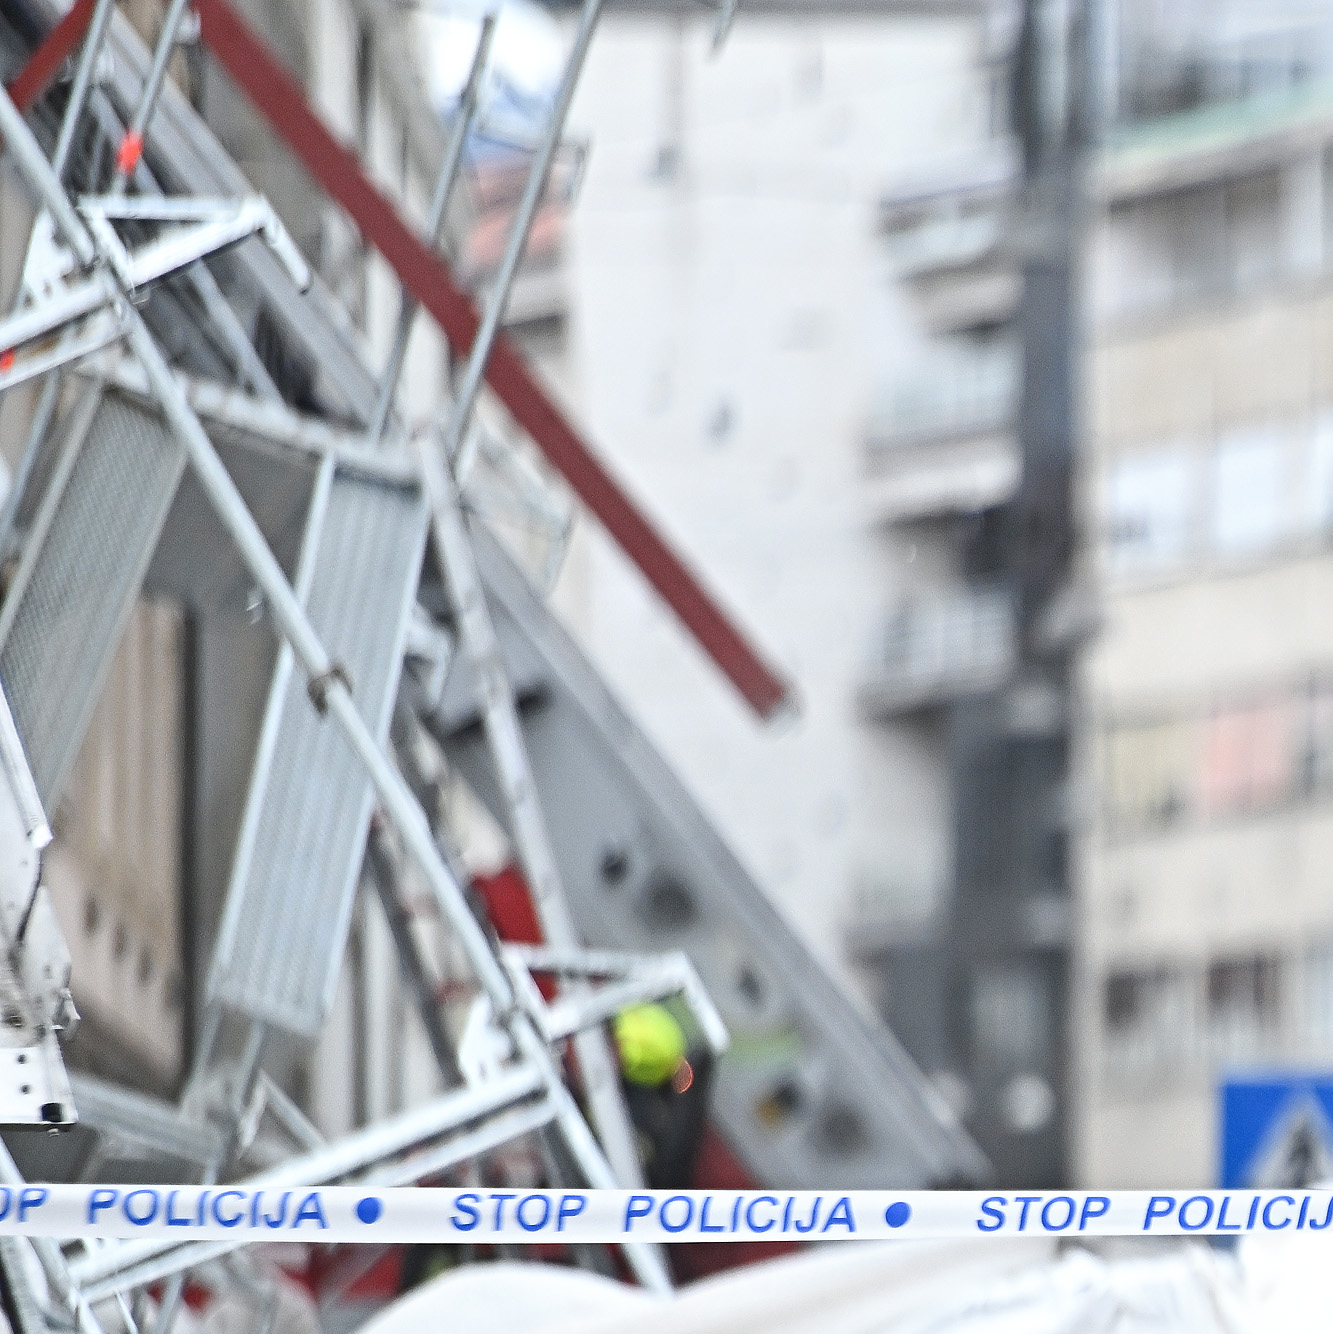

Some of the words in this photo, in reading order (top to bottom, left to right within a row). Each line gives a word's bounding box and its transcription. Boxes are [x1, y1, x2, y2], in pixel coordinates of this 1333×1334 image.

[86, 1188, 330, 1230] POLICIJA
[449, 1193, 589, 1233] STOP
[622, 1195, 857, 1234] POLICIJA
[975, 1195, 1112, 1233] STOP
